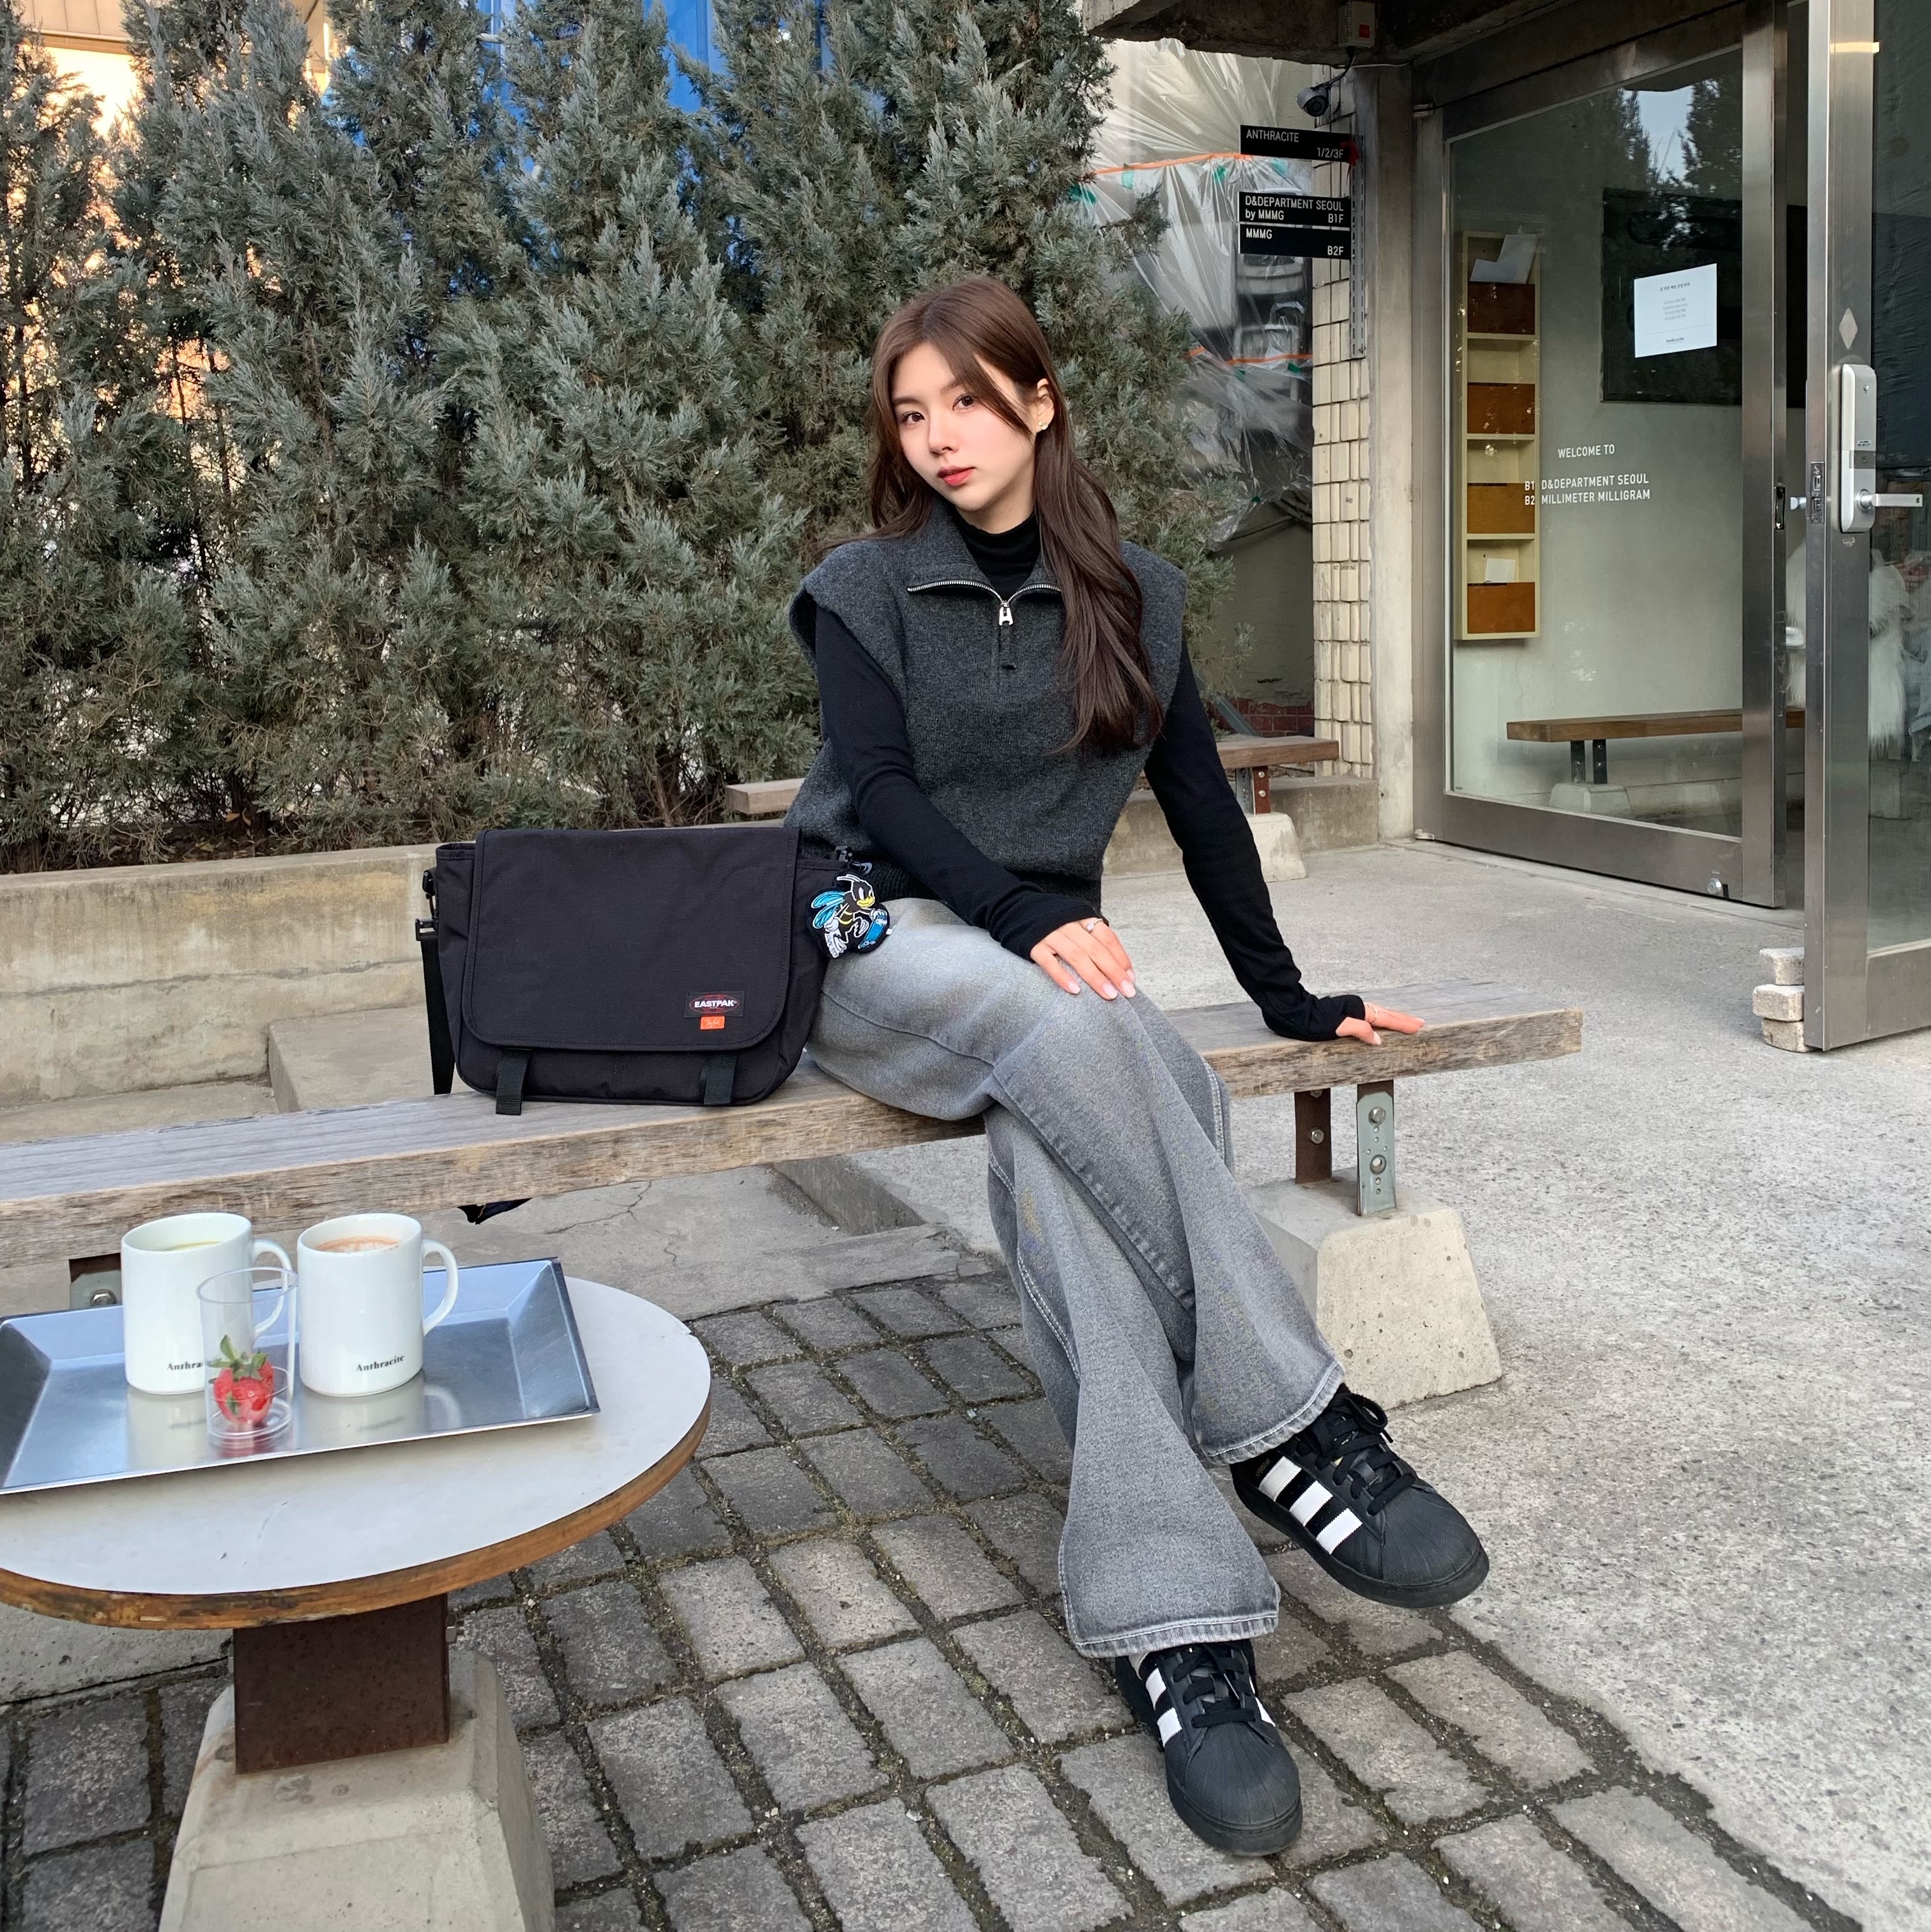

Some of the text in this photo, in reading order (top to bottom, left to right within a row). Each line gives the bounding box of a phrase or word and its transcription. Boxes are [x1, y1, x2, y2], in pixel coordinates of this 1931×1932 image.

[1246, 129, 1299, 142] ANTHRACITE
[1317, 148, 1344, 158] 1/2/3F
[1246, 195, 1344, 211] D&DEPARTMENT SEOUL
[1246, 209, 1284, 220] by MMMG
[1328, 213, 1344, 224] B1F
[1246, 228, 1272, 240] MMMG
[1327, 246, 1344, 256] B2F
[1558, 444, 1615, 458] WELCOME TO
[1525, 473, 1649, 491] B1 D&DEPARTMENT SEOUL
[1525, 489, 1651, 505] B2 MILLIMETER MILLIGRAM
[356, 1356, 404, 1372] Anthracite
